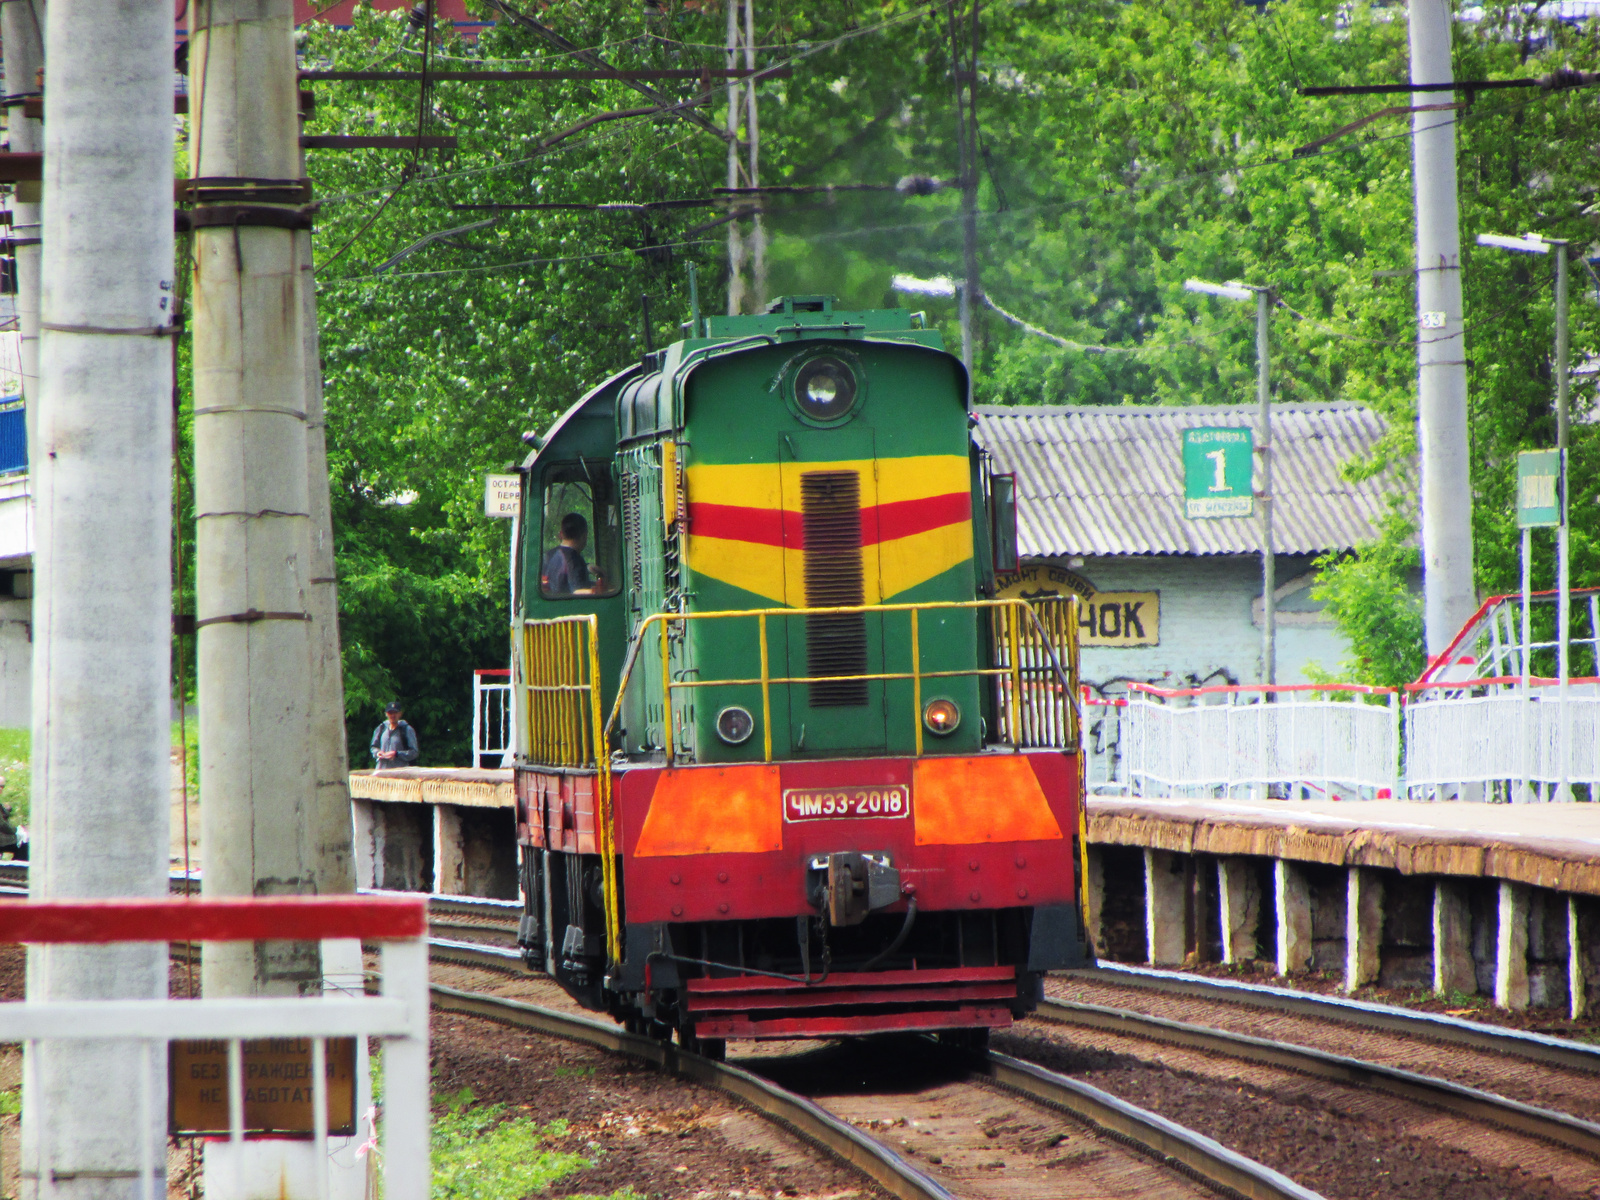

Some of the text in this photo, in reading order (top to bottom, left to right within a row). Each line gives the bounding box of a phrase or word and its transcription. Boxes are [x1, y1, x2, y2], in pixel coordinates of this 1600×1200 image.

[1423, 313, 1441, 326] 33
[1205, 448, 1233, 492] 1
[492, 480, 521, 488] ОСТАН
[497, 491, 521, 500] ПЕРВ
[499, 502, 519, 512] ВАГ
[995, 568, 1095, 602] МОНТ ОБУВИ
[188, 1038, 263, 1054] ОПАСОЕ
[191, 1063, 221, 1079] БЕЗ
[200, 1087, 314, 1103] НЕ АБОТАТ
